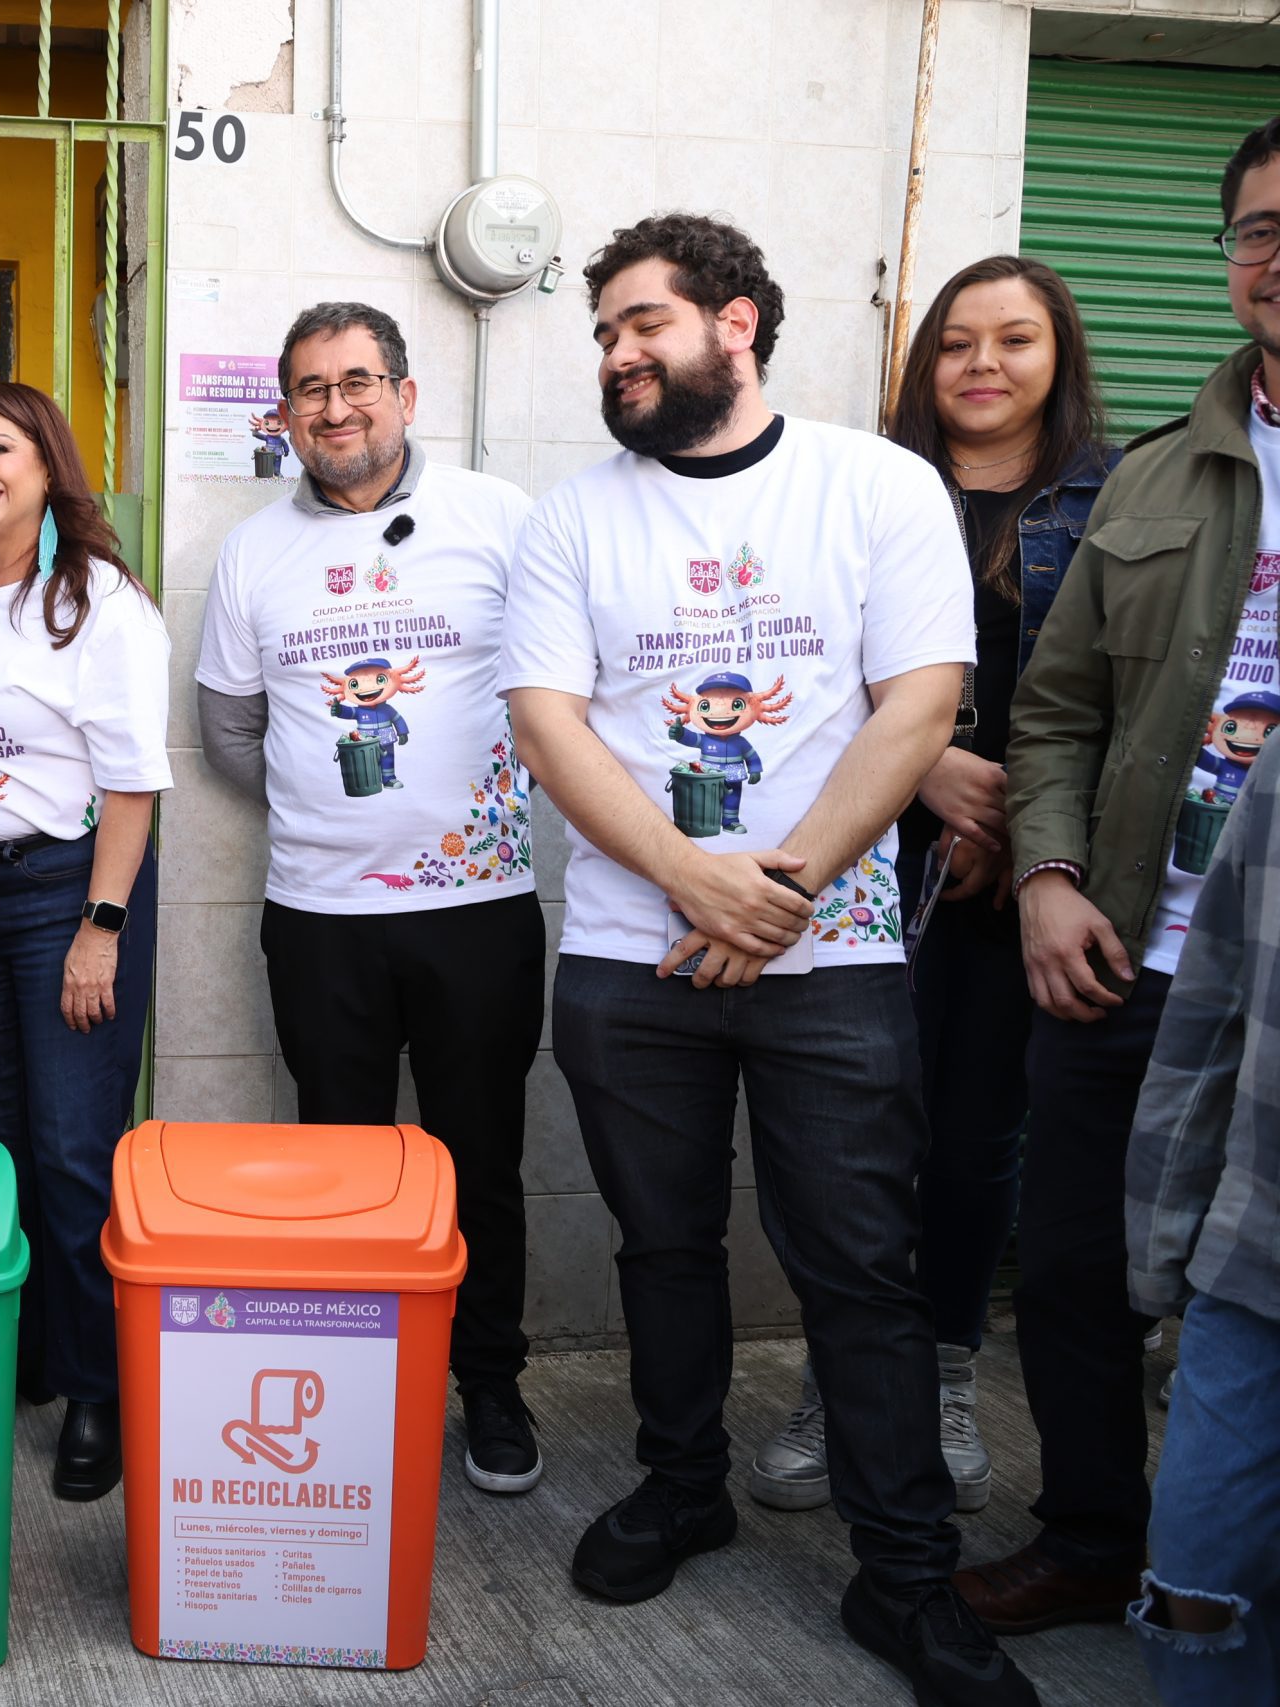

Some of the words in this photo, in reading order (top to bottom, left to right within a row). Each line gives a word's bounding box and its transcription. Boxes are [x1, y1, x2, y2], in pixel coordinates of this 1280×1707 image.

[174, 111, 246, 164] 50
[192, 375, 245, 386] TRANSFORMA
[248, 377, 257, 386] TU
[186, 386, 207, 397] CADA
[210, 387, 243, 398] RESIDUO
[246, 389, 256, 398] EN
[259, 389, 268, 399] SU
[312, 605, 351, 617] CIUDAD
[372, 599, 413, 608] MÉXICO
[674, 607, 718, 619] CIUDAD
[721, 604, 737, 618] DE
[739, 594, 780, 612] MÉXICO
[282, 622, 369, 648] TRANSFORMA
[374, 621, 390, 635] TU
[396, 615, 451, 634] CIUDAD,
[636, 629, 735, 651] TRANSFORMA
[741, 623, 753, 643] TU
[758, 616, 816, 637] CIUDAD,
[278, 650, 307, 666] CADA
[312, 640, 367, 661] RESIDUO
[373, 638, 389, 652] EN
[395, 636, 412, 650] SU
[417, 632, 461, 649] LUGAR
[629, 654, 663, 672] CADA
[669, 647, 731, 668] RESIDUO
[737, 647, 752, 664] EN
[757, 643, 775, 659] SU
[781, 638, 824, 657] LUGAR
[245, 1301, 299, 1314] CIUDAD
[303, 1303, 322, 1314] DE
[326, 1301, 381, 1317] MÉXICO
[245, 1318, 277, 1326] CAPITAL
[280, 1318, 291, 1327] DE
[293, 1319, 302, 1327] LA
[305, 1319, 381, 1329] TRANSFORMACIÓN
[173, 1478, 203, 1503] NO
[212, 1479, 372, 1510] RECICLABLES
[180, 1522, 213, 1533] Lunes,
[216, 1524, 268, 1535] miércoles,
[270, 1527, 306, 1536] viernes
[309, 1529, 315, 1538] y
[318, 1528, 362, 1539] domingo
[185, 1546, 223, 1555] Residuos
[225, 1547, 266, 1557] sanitarios
[282, 1550, 312, 1559] Curitas
[185, 1557, 223, 1566] Pañuelos
[225, 1559, 255, 1568] usados
[282, 1561, 315, 1571] Pañales
[185, 1568, 209, 1578] Papel
[211, 1569, 220, 1577] de
[223, 1570, 243, 1578] baño
[282, 1572, 326, 1583] Tampones
[185, 1579, 241, 1589] Preservativos
[282, 1583, 313, 1593] Colillas
[315, 1585, 325, 1593] de
[327, 1585, 362, 1596] cigarros
[185, 1590, 215, 1599] Toallas
[217, 1592, 257, 1601] sanitarias
[281, 1594, 312, 1604] Chicles
[185, 1601, 218, 1611] Hisopos
